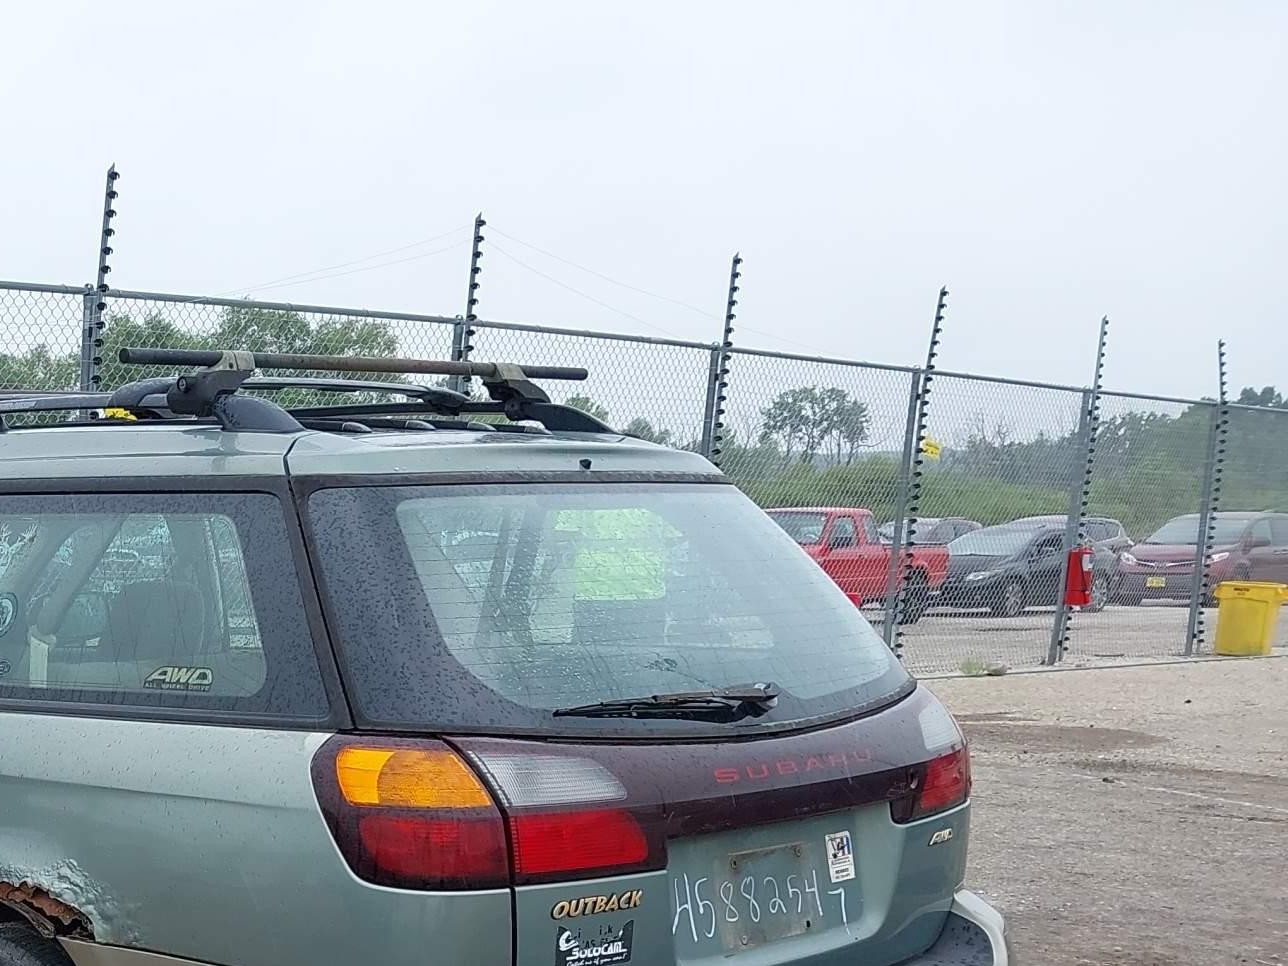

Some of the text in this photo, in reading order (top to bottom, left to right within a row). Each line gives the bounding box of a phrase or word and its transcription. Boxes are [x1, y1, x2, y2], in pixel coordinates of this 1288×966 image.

[145, 666, 213, 685] AWD
[713, 748, 872, 784] SUBARU
[552, 889, 643, 919] OUTBACK
